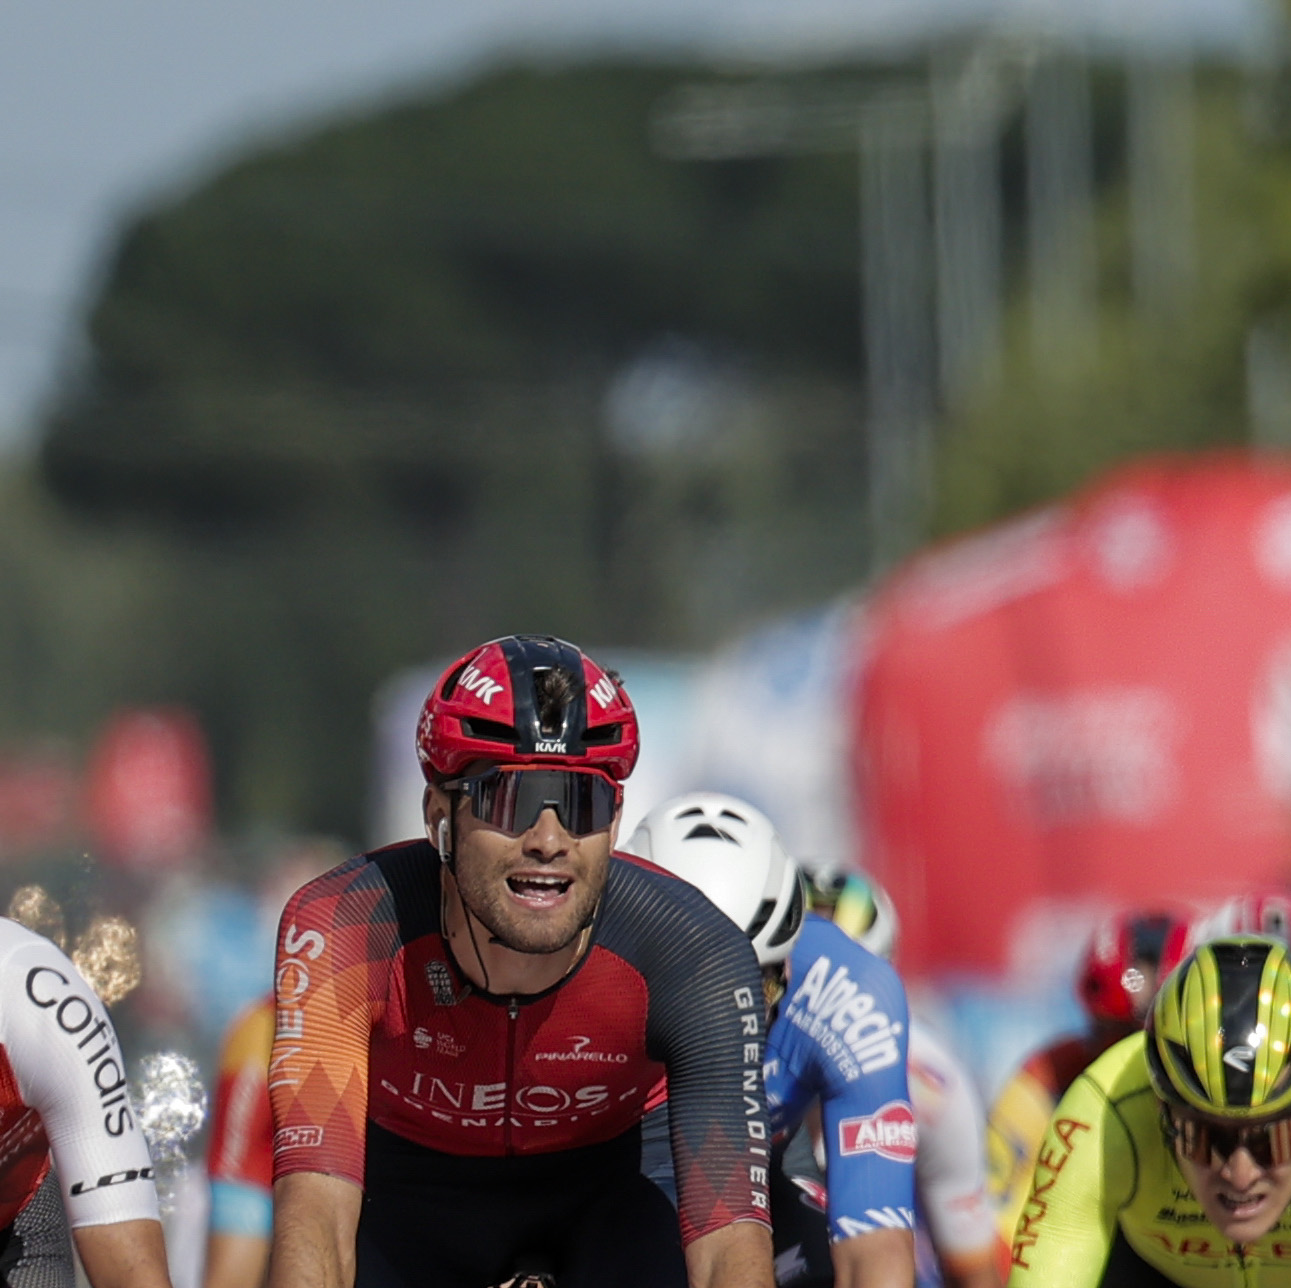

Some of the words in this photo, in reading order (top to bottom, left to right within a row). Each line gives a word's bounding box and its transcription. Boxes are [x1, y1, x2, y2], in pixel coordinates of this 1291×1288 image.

[535, 742, 567, 753] KASK
[25, 966, 135, 1139] Cofidis
[268, 924, 326, 1091] INEOS
[535, 1051, 628, 1064] PINARELLO
[793, 954, 901, 1076] Alpecin
[413, 1070, 610, 1114] INEOS
[733, 985, 768, 1210] GRENADIER
[1011, 1117, 1091, 1271] ARKEA
